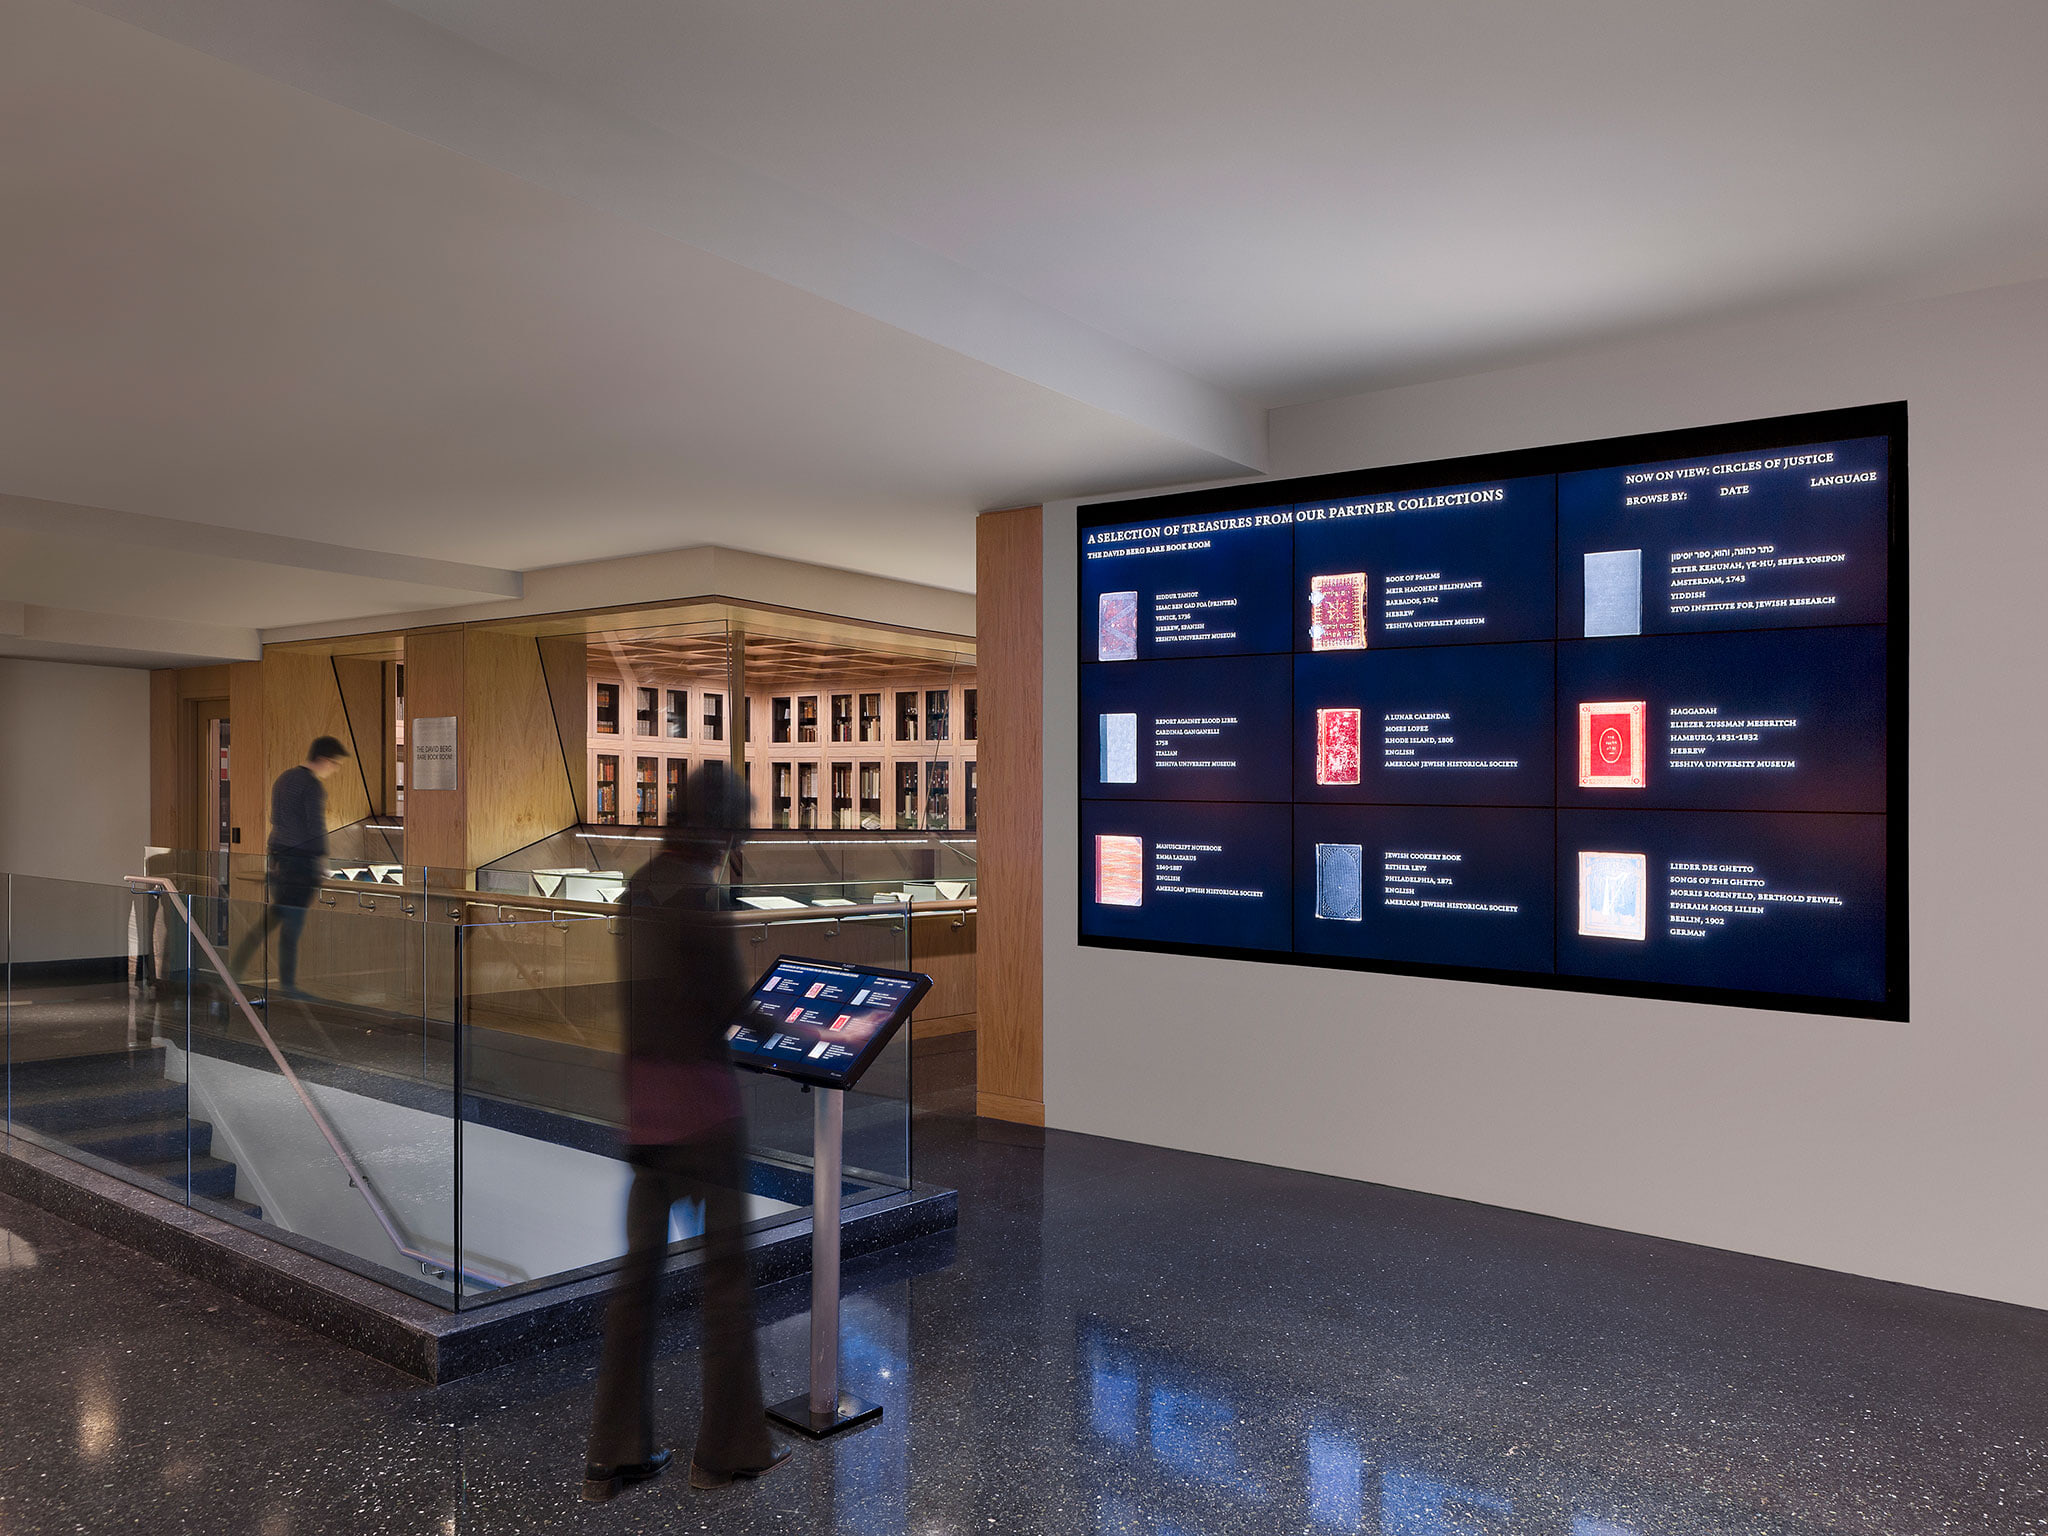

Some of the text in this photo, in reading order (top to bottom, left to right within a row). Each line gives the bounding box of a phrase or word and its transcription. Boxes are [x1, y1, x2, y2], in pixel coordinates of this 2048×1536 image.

[1626, 453, 1833, 484] NOW ON VIEW: CIRCLES OF JUSTICE
[1626, 472, 1877, 505] BROWSE BY: DATE LANGUAGE
[1088, 489, 1503, 544] A SELECTION OF TREASURES FROM OUR PARTNER COLLECTIONS
[1087, 541, 1210, 560] THE DAVID BERG RARE BOOK ROOM
[1671, 565, 1698, 574] KETER
[1699, 562, 1744, 571] KEHUNAH,
[1778, 557, 1805, 565] SEFER
[1805, 554, 1845, 563] YOSIPON
[1386, 572, 1440, 583] BOOK OF PSALMS
[1671, 575, 1745, 586] AMSTERDAM, 1743
[1386, 582, 1482, 595] MEIR HACOHEN BELINFANTE
[1671, 591, 1705, 599] YIDDISH
[1386, 596, 1438, 606] BARBADOS, 1742
[1671, 596, 1835, 614] YIVO INSTITUTE FOR JEWISH RESEARCH
[1156, 614, 1177, 622] VENICE,
[1386, 609, 1414, 618] HEBREW
[1385, 617, 1485, 630] YESHIVA UNIVERSITY MUSEUM
[1156, 631, 1236, 643] YESHIVA UNIVERSITY MUSEUM
[1391, 713, 1413, 721] LUNAR
[1414, 712, 1450, 721] CALENDAR
[1671, 707, 1717, 716] HAGGADAH
[1385, 725, 1406, 733] MOSES
[1671, 719, 1796, 729] ELIEZER ZUSSMAN MESERITCH
[1156, 728, 1183, 736] CARDINAL
[1410, 737, 1436, 745] ISLAND,
[1438, 736, 1454, 744] 1806
[1671, 734, 1714, 742] HAMBURG,
[1670, 747, 1706, 755] HEBREW
[1156, 760, 1178, 768] YESHIVA
[1385, 760, 1518, 769] AMERICAN JEWISH HISTORICAL SOCIETY
[1670, 760, 1795, 768] YESHIVA UNIVERSITY MUSEUM
[1156, 843, 1222, 852] MANUSCRIPT NOTEBOOK
[1385, 851, 1461, 862] JEWISH COOKERY BOOK
[1385, 863, 1427, 872] ESTHER LEVY
[1670, 862, 1754, 873] LIEDER DES GHETTO
[1156, 874, 1180, 882] ENGLISH
[1385, 876, 1436, 884] PHILADELPHIA,
[1670, 875, 1765, 887] SONGS OF THE GHETTO
[1156, 885, 1263, 898] AMERICAN JEWISH HISTORICAL SOCIETY
[1385, 886, 1414, 895] ENGLISH
[1670, 889, 1842, 905] MORRIS ROSENFELD, BERTHOLD FEIWEL,
[1385, 898, 1518, 913] AMERICAN JEWISH HISTORICAL SOCIETY
[1670, 902, 1764, 914] EPHRAIM MOSE LILIEN
[1670, 915, 1724, 926] BERLIN, 1902
[1670, 928, 1705, 937] GERMAN
